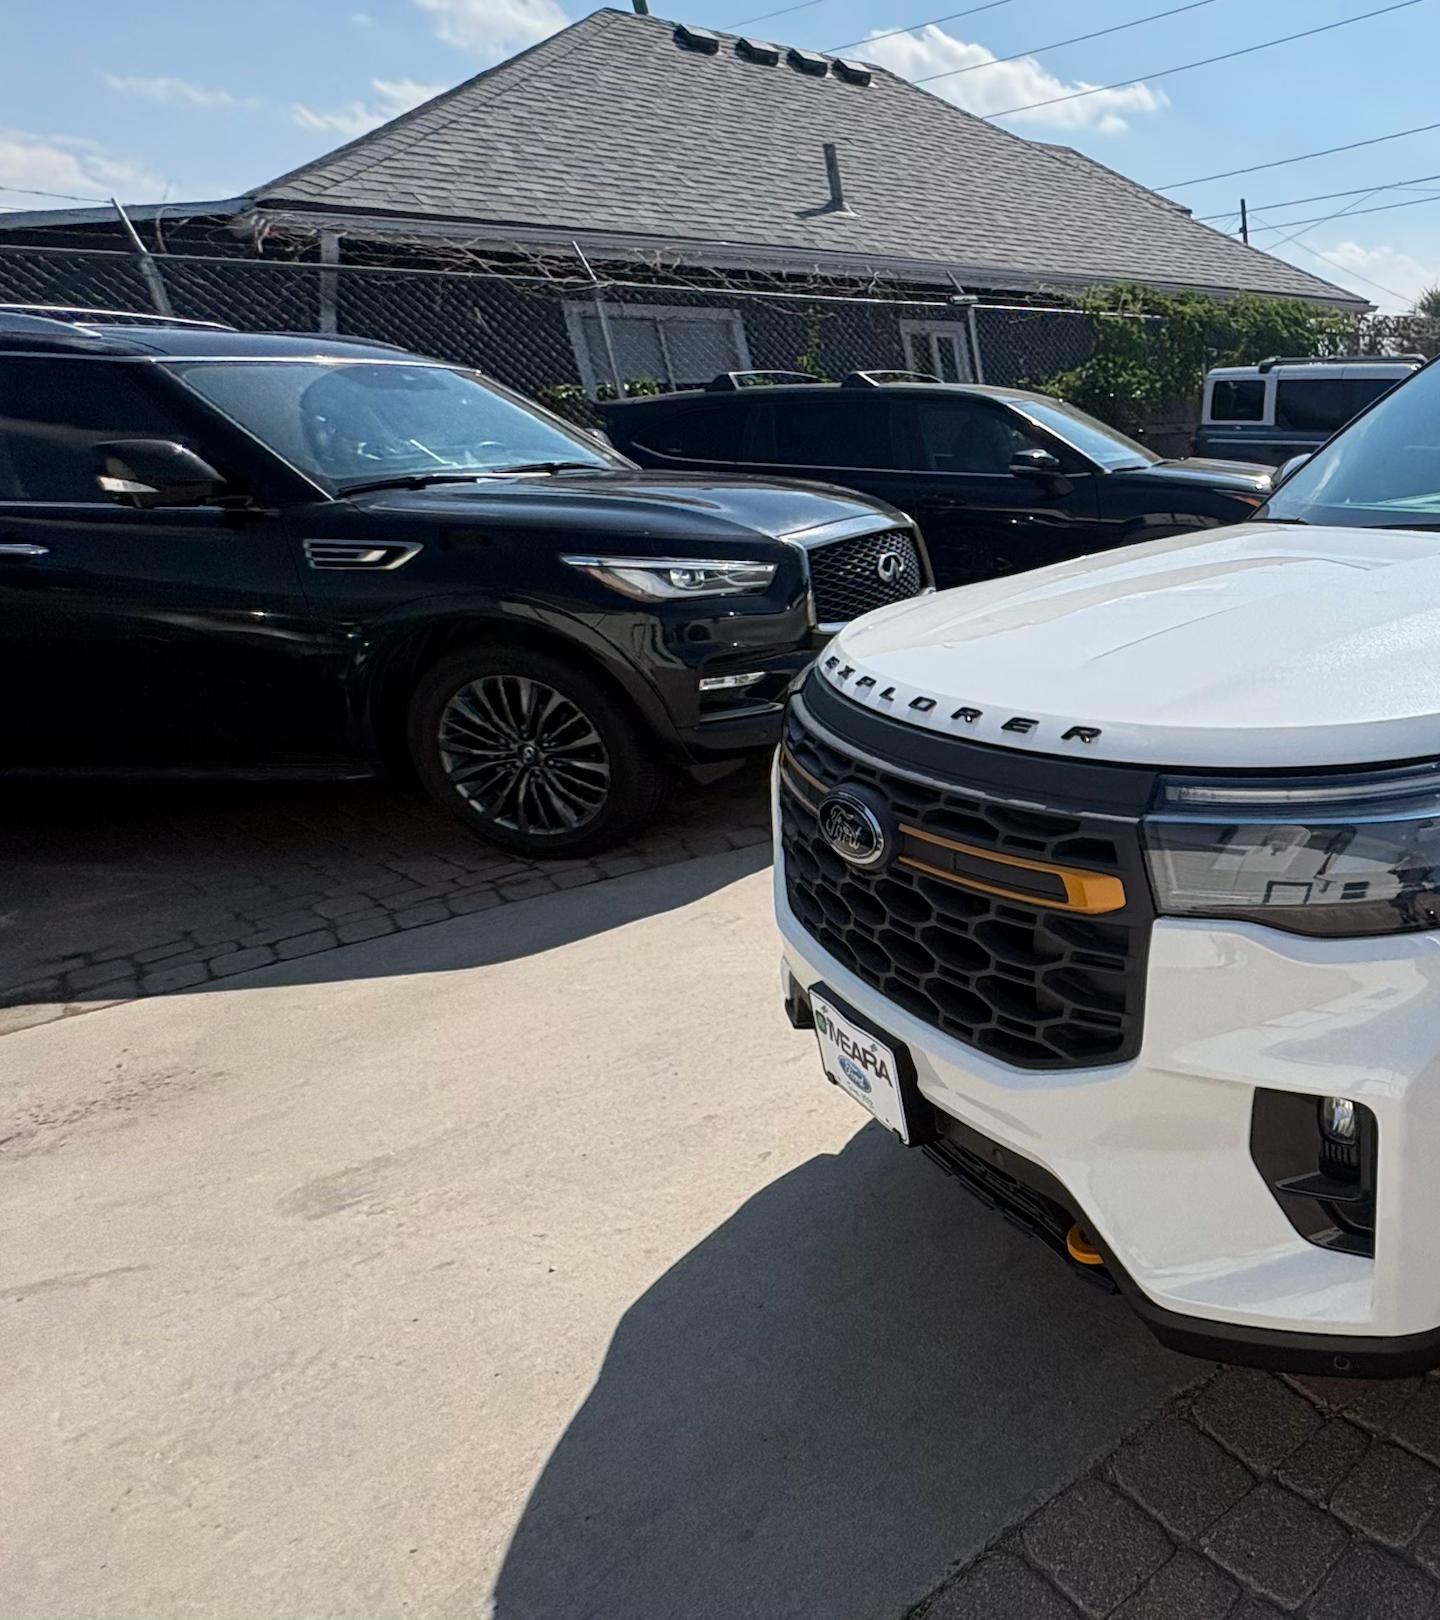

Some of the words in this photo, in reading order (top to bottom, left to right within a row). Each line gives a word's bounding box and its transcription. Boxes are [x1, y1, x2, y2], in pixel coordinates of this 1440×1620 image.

[825, 656, 1102, 744] EXPLORER
[825, 804, 864, 850] Ford
[842, 1058, 868, 1090] Ford
